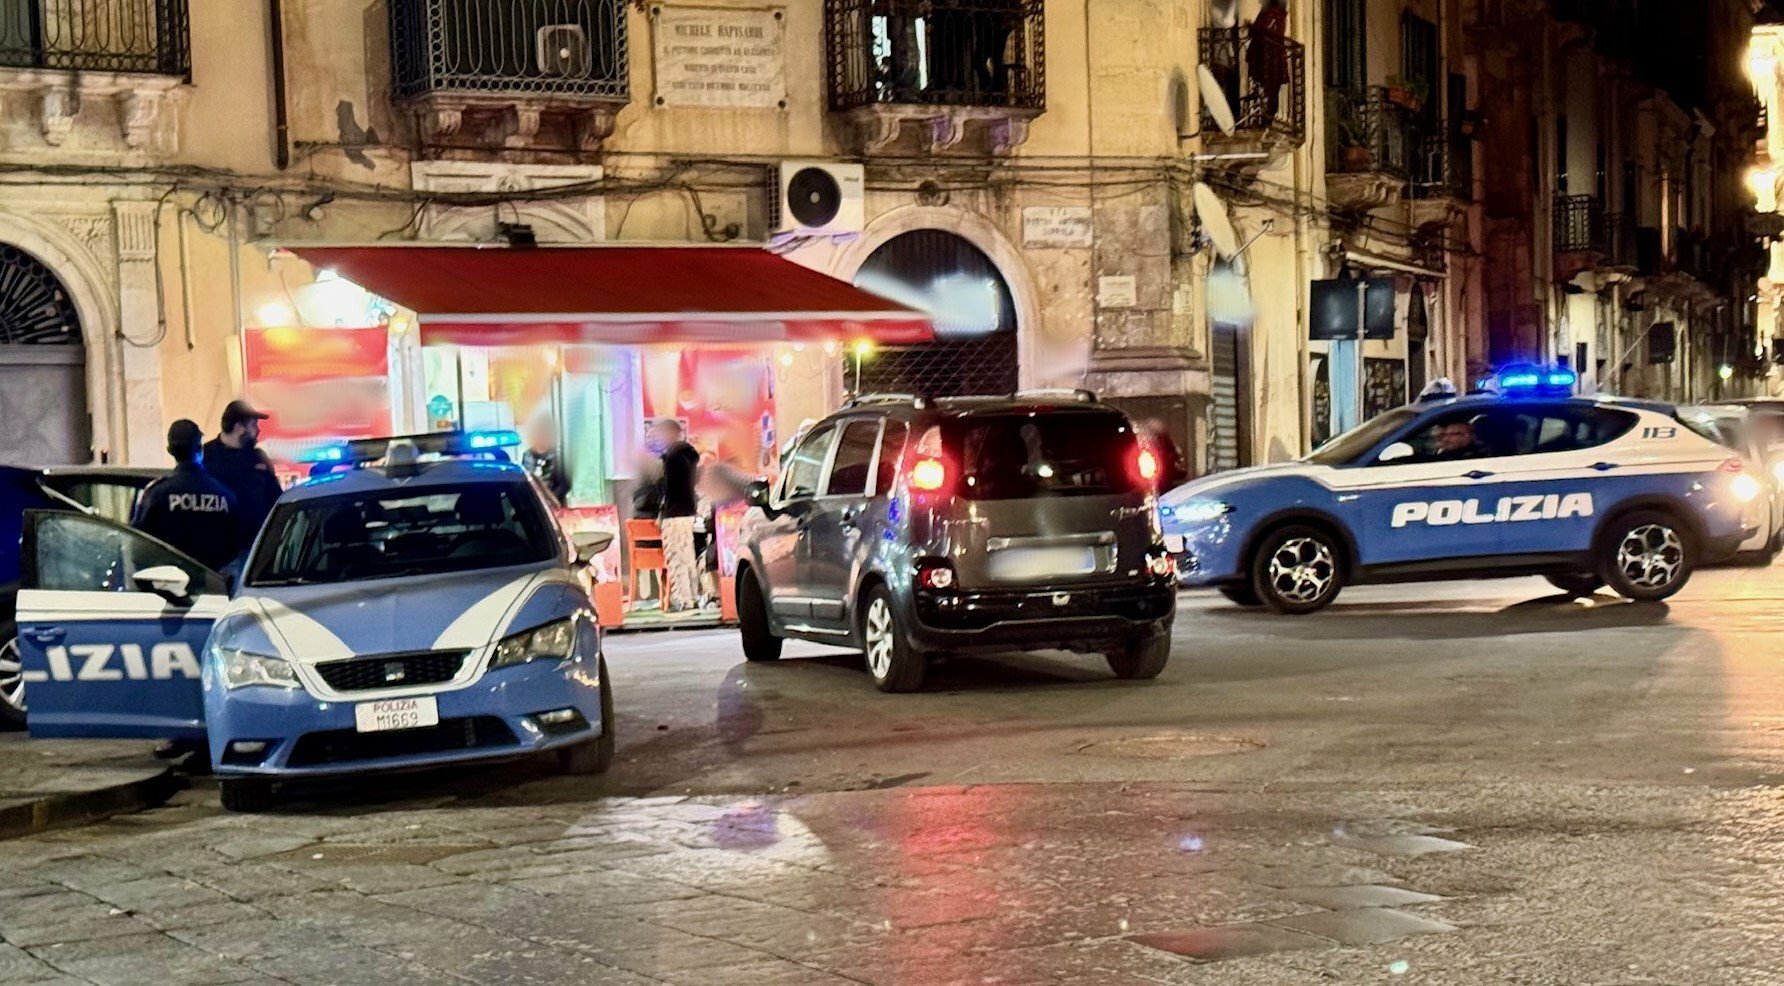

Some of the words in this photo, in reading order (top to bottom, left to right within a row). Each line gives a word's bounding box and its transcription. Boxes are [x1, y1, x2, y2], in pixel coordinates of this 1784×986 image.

[168, 492, 230, 513] POLIZIA
[1391, 492, 1594, 528] POLIZIA
[374, 700, 418, 713] POLIZIA
[376, 712, 418, 729] M1669
